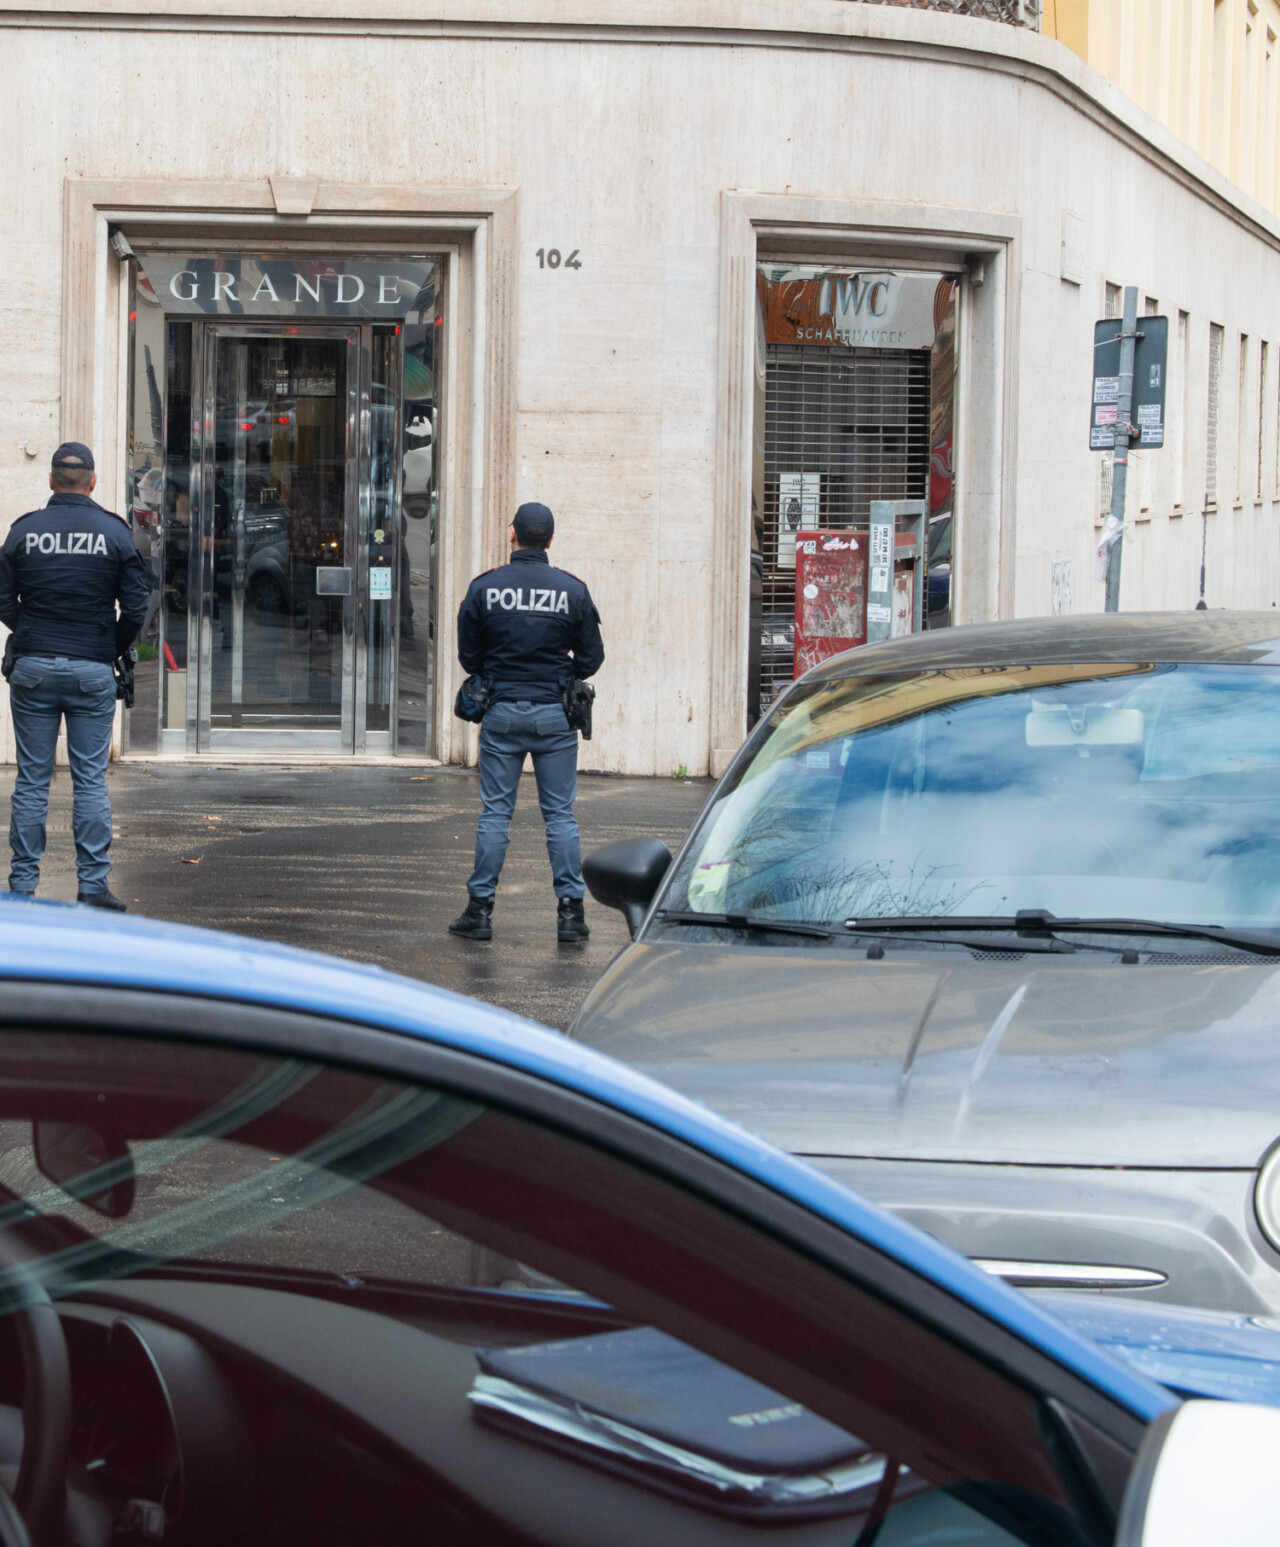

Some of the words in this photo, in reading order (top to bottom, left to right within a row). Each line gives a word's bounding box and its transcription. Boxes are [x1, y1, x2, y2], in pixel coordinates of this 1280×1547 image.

[535, 248, 582, 270] 104
[169, 270, 402, 305] GRANDE
[819, 278, 890, 318] IWC
[796, 327, 907, 343] SCHAFFHAUSEN
[25, 532, 108, 556] POLIZIA
[486, 587, 569, 614] POLIZIA
